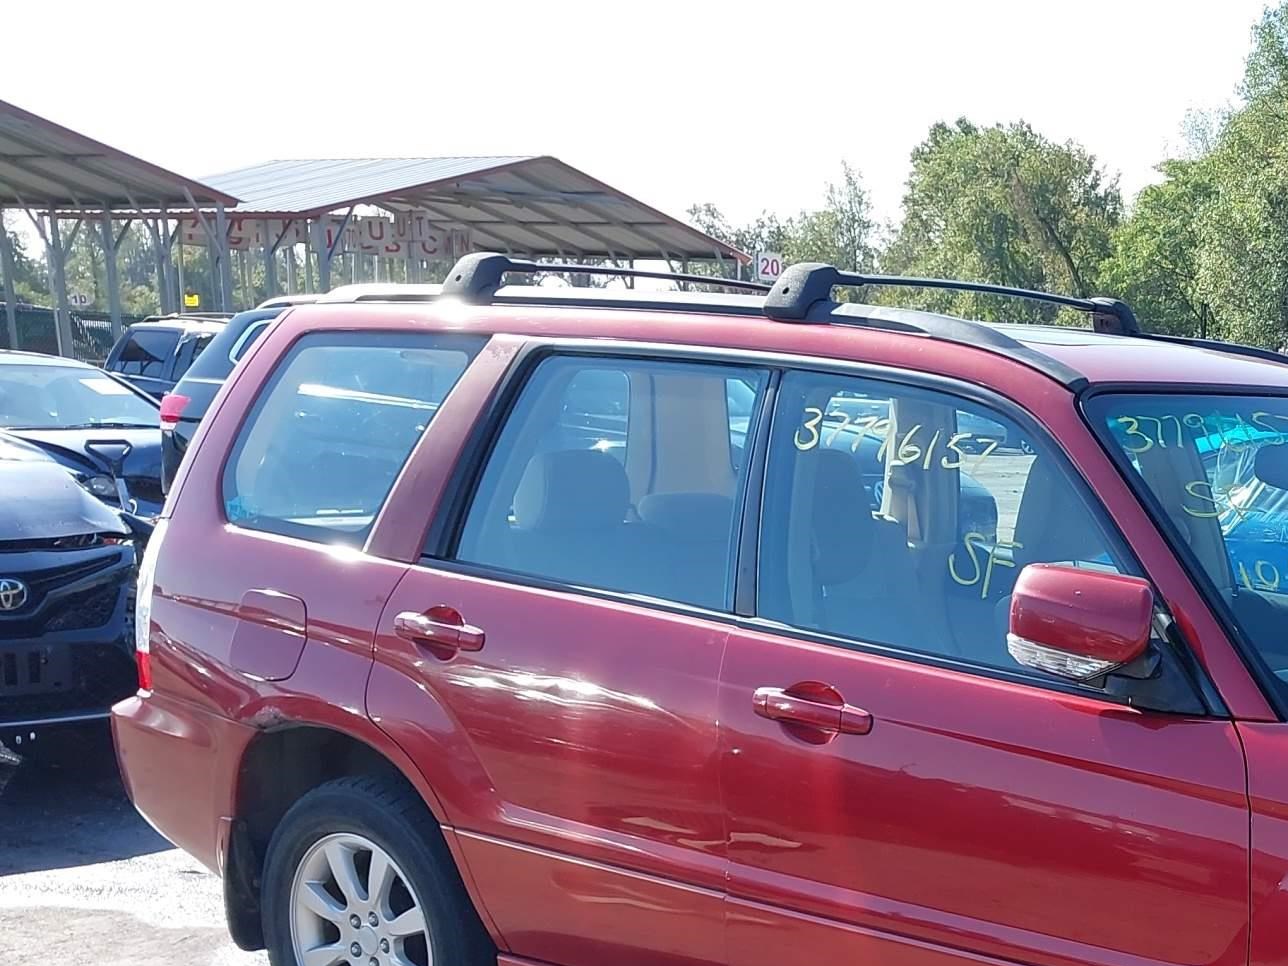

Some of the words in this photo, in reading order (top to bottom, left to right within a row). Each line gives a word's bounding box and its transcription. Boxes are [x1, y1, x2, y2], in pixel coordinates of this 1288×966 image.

[761, 257, 780, 276] 20
[794, 407, 999, 473] 37796157
[948, 531, 1024, 599] SF
